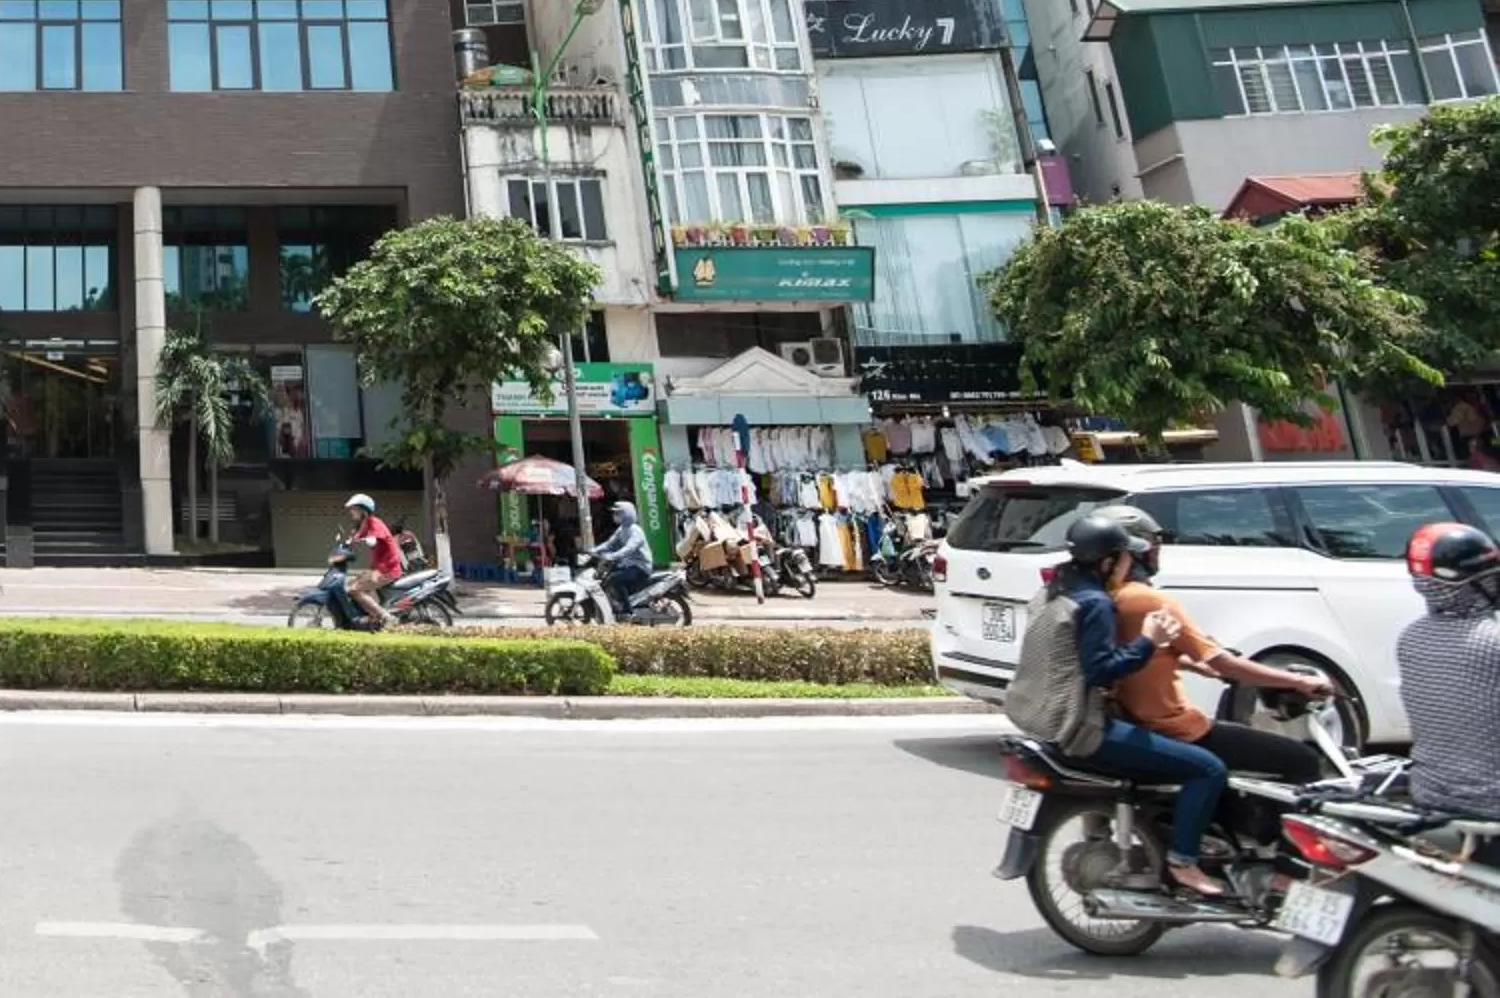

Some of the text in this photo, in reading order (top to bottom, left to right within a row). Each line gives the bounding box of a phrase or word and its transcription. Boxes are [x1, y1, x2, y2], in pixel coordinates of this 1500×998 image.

[842, 13, 955, 50] Lucky 7
[641, 450, 661, 530] Kangaroo
